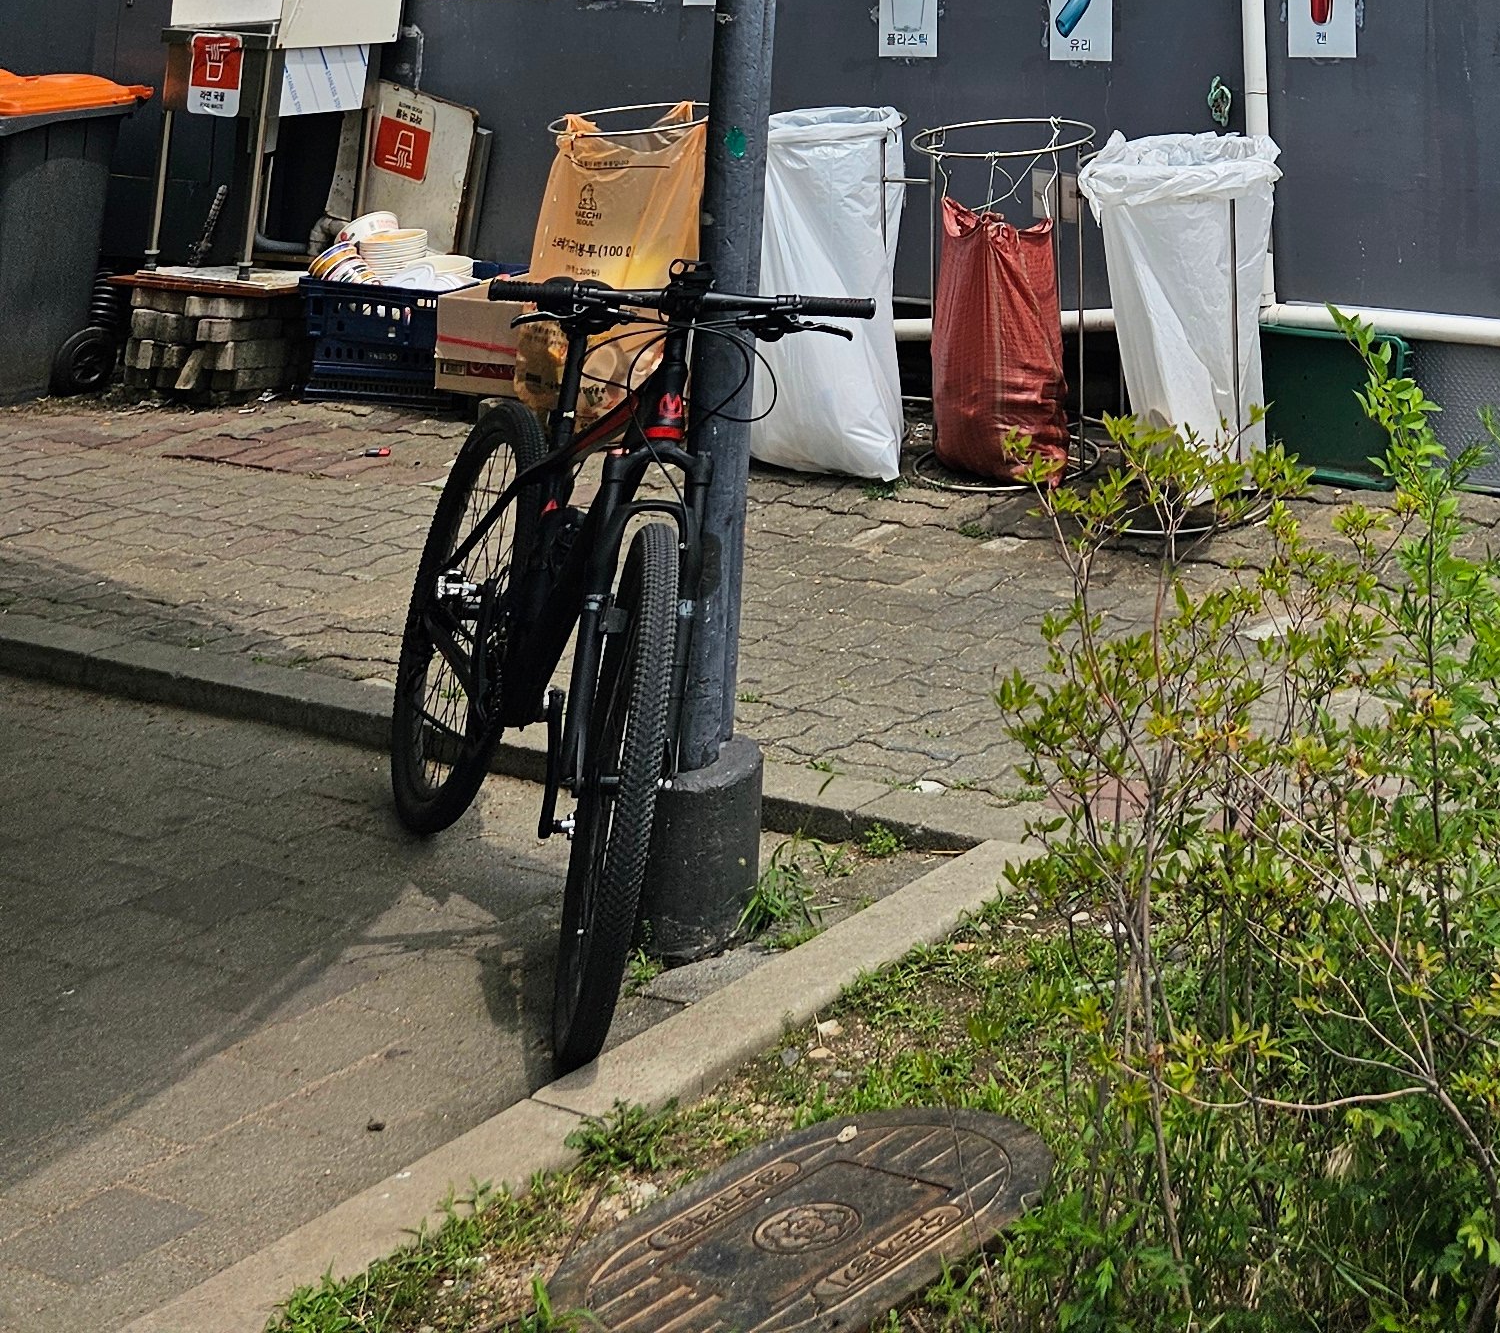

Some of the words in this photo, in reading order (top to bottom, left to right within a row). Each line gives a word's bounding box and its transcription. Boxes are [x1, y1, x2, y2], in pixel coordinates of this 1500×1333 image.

[886, 32, 930, 47] 플라스틱
[1069, 37, 1092, 53] 유리
[1315, 30, 1329, 46] 캔
